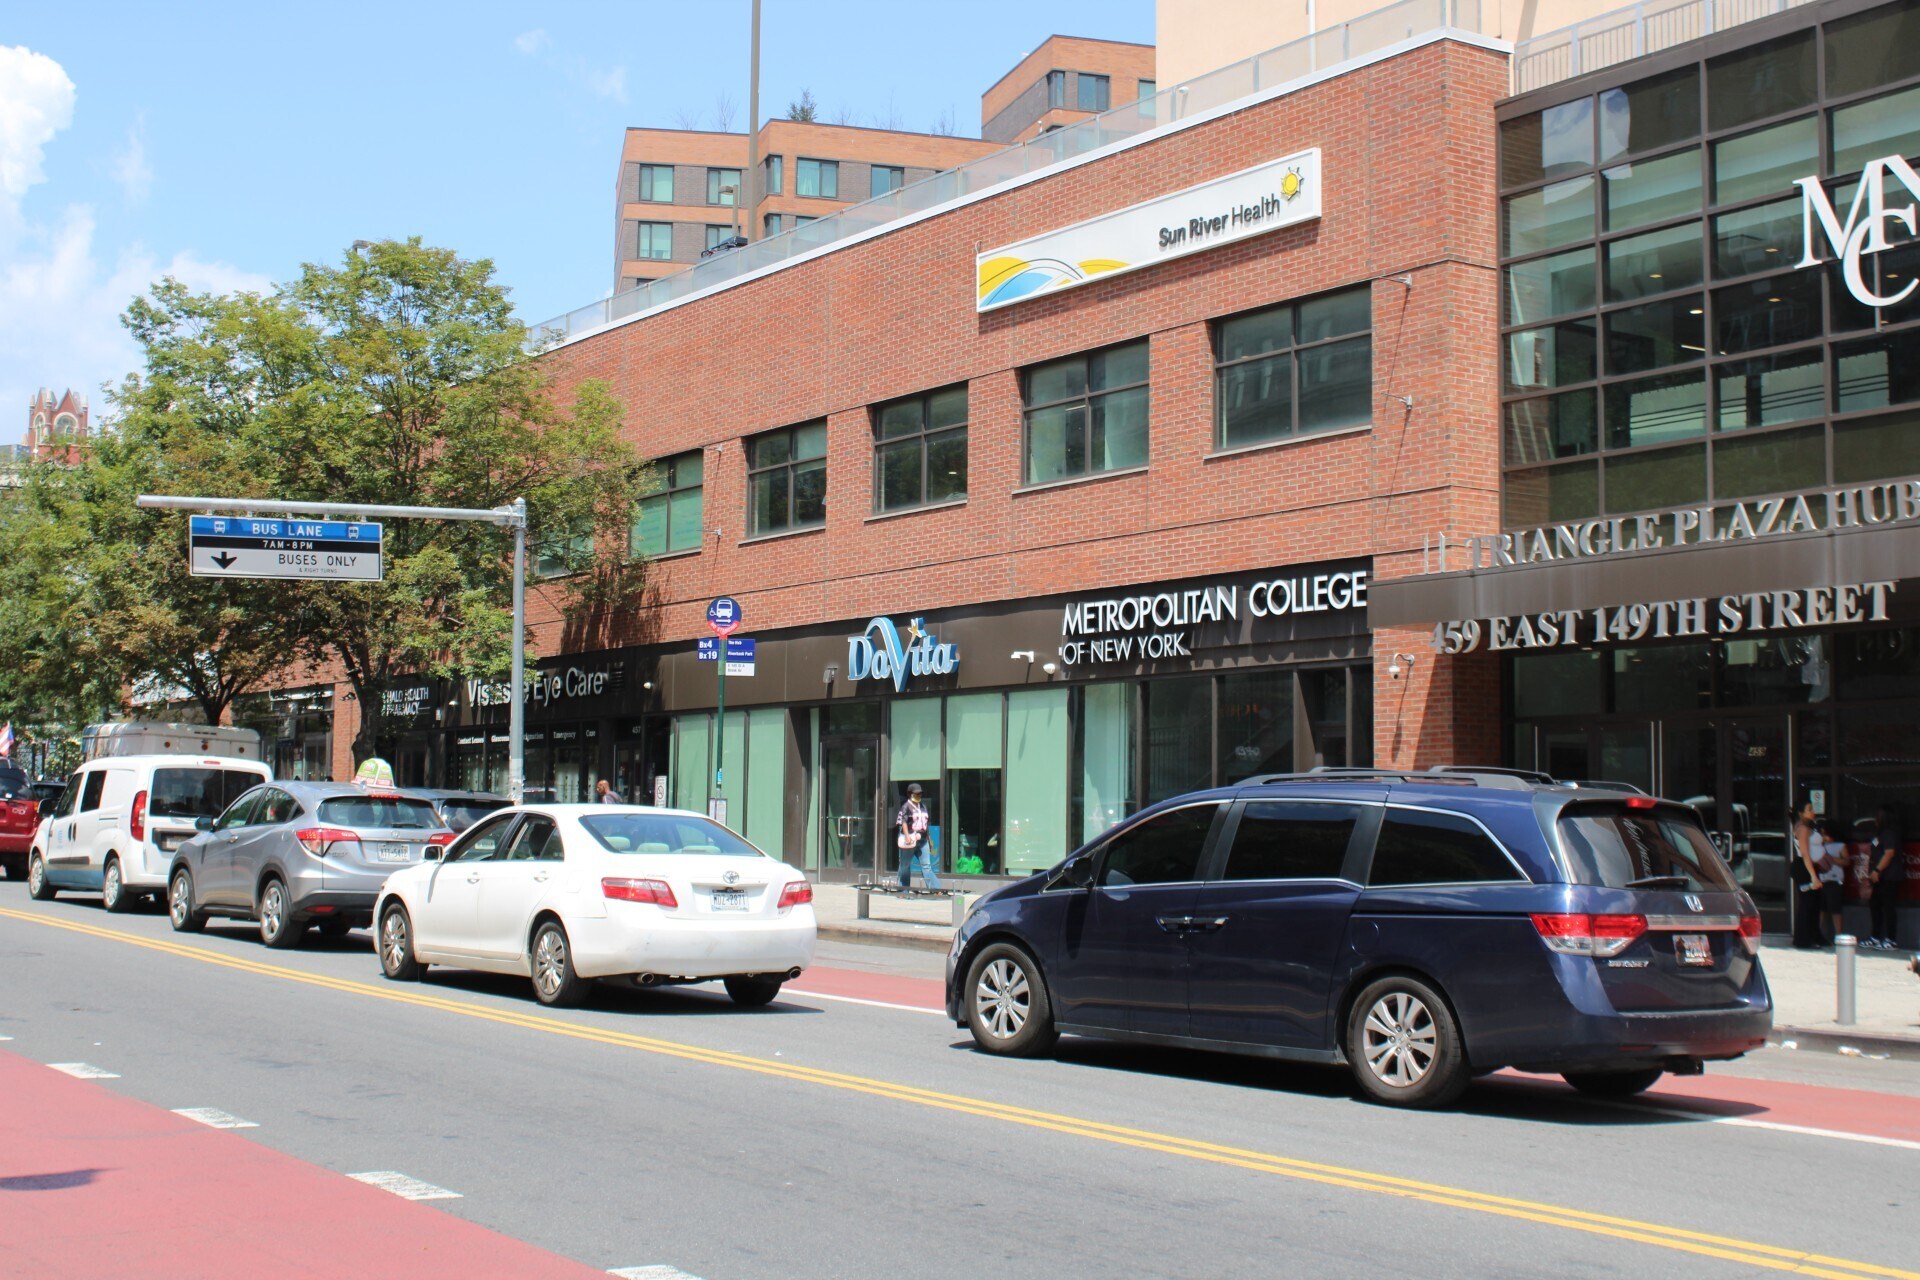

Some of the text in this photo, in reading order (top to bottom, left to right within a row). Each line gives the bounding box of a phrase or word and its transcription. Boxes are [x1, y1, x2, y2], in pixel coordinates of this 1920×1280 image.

[1159, 193, 1280, 247] Sun River Health
[252, 523, 323, 537] BUS LANE
[1465, 513, 1663, 569] TRIANGLE
[1671, 494, 1817, 547] PLAZA
[1825, 481, 1920, 530] HUB
[278, 553, 357, 567] BUSES ONLY
[1062, 570, 1368, 636] METROPOLITAN COLLEGE
[1429, 579, 1899, 655] 459 EAST 149TH STREET
[699, 640, 712, 648] Bx4
[699, 651, 717, 660] Bx19
[848, 617, 960, 693] DaVita
[1063, 632, 1186, 665] OF NEW YORK
[533, 671, 561, 707] Eye
[566, 667, 604, 698] Care
